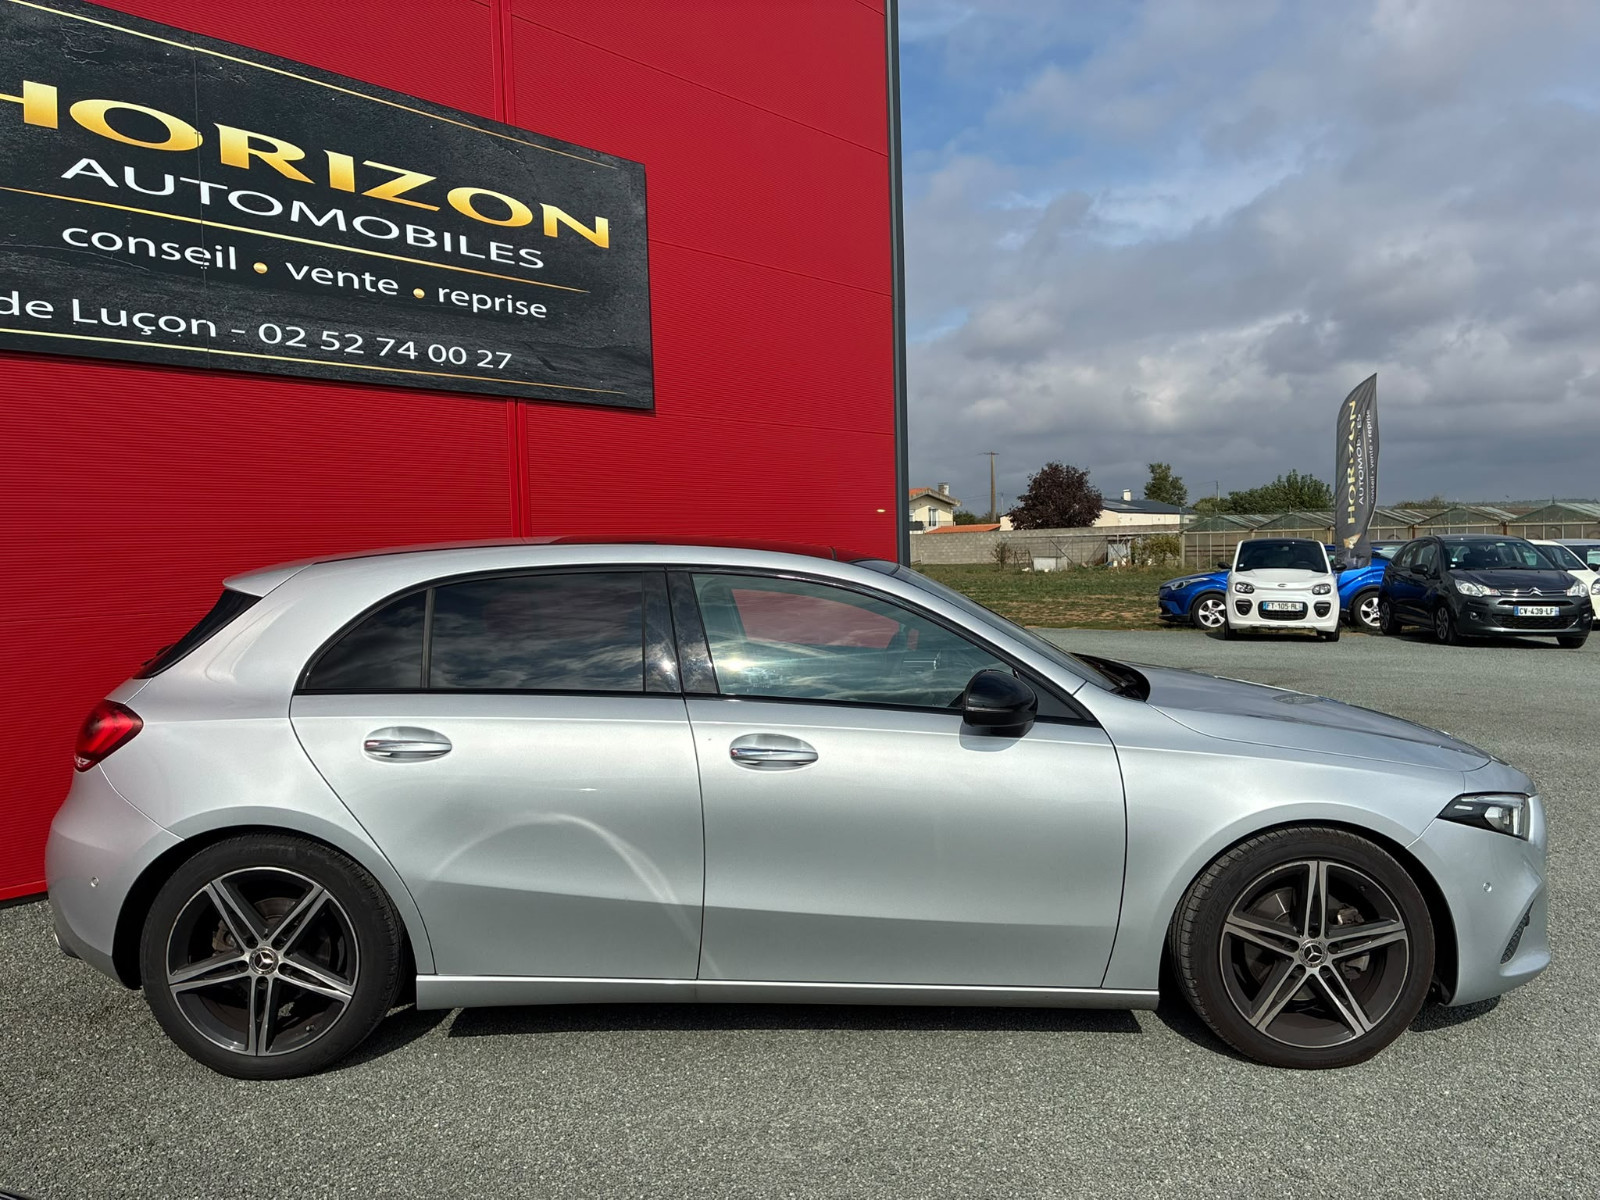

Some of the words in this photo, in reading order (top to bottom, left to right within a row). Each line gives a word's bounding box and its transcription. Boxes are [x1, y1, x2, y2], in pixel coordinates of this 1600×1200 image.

[0, 80, 609, 249] HORIZON
[61, 158, 544, 269] AUTOMOBILES
[62, 228, 236, 270] conseil
[285, 262, 399, 295] vente
[438, 287, 547, 318] reprise
[0, 291, 54, 319] de
[72, 298, 216, 337] Luçon
[258, 323, 307, 348] 02
[321, 331, 364, 354] 52
[376, 337, 418, 360] 74
[428, 344, 467, 365] 00
[477, 349, 512, 369] 27
[1347, 400, 1356, 525] HORZON
[1356, 413, 1364, 504] AUTOMOBES
